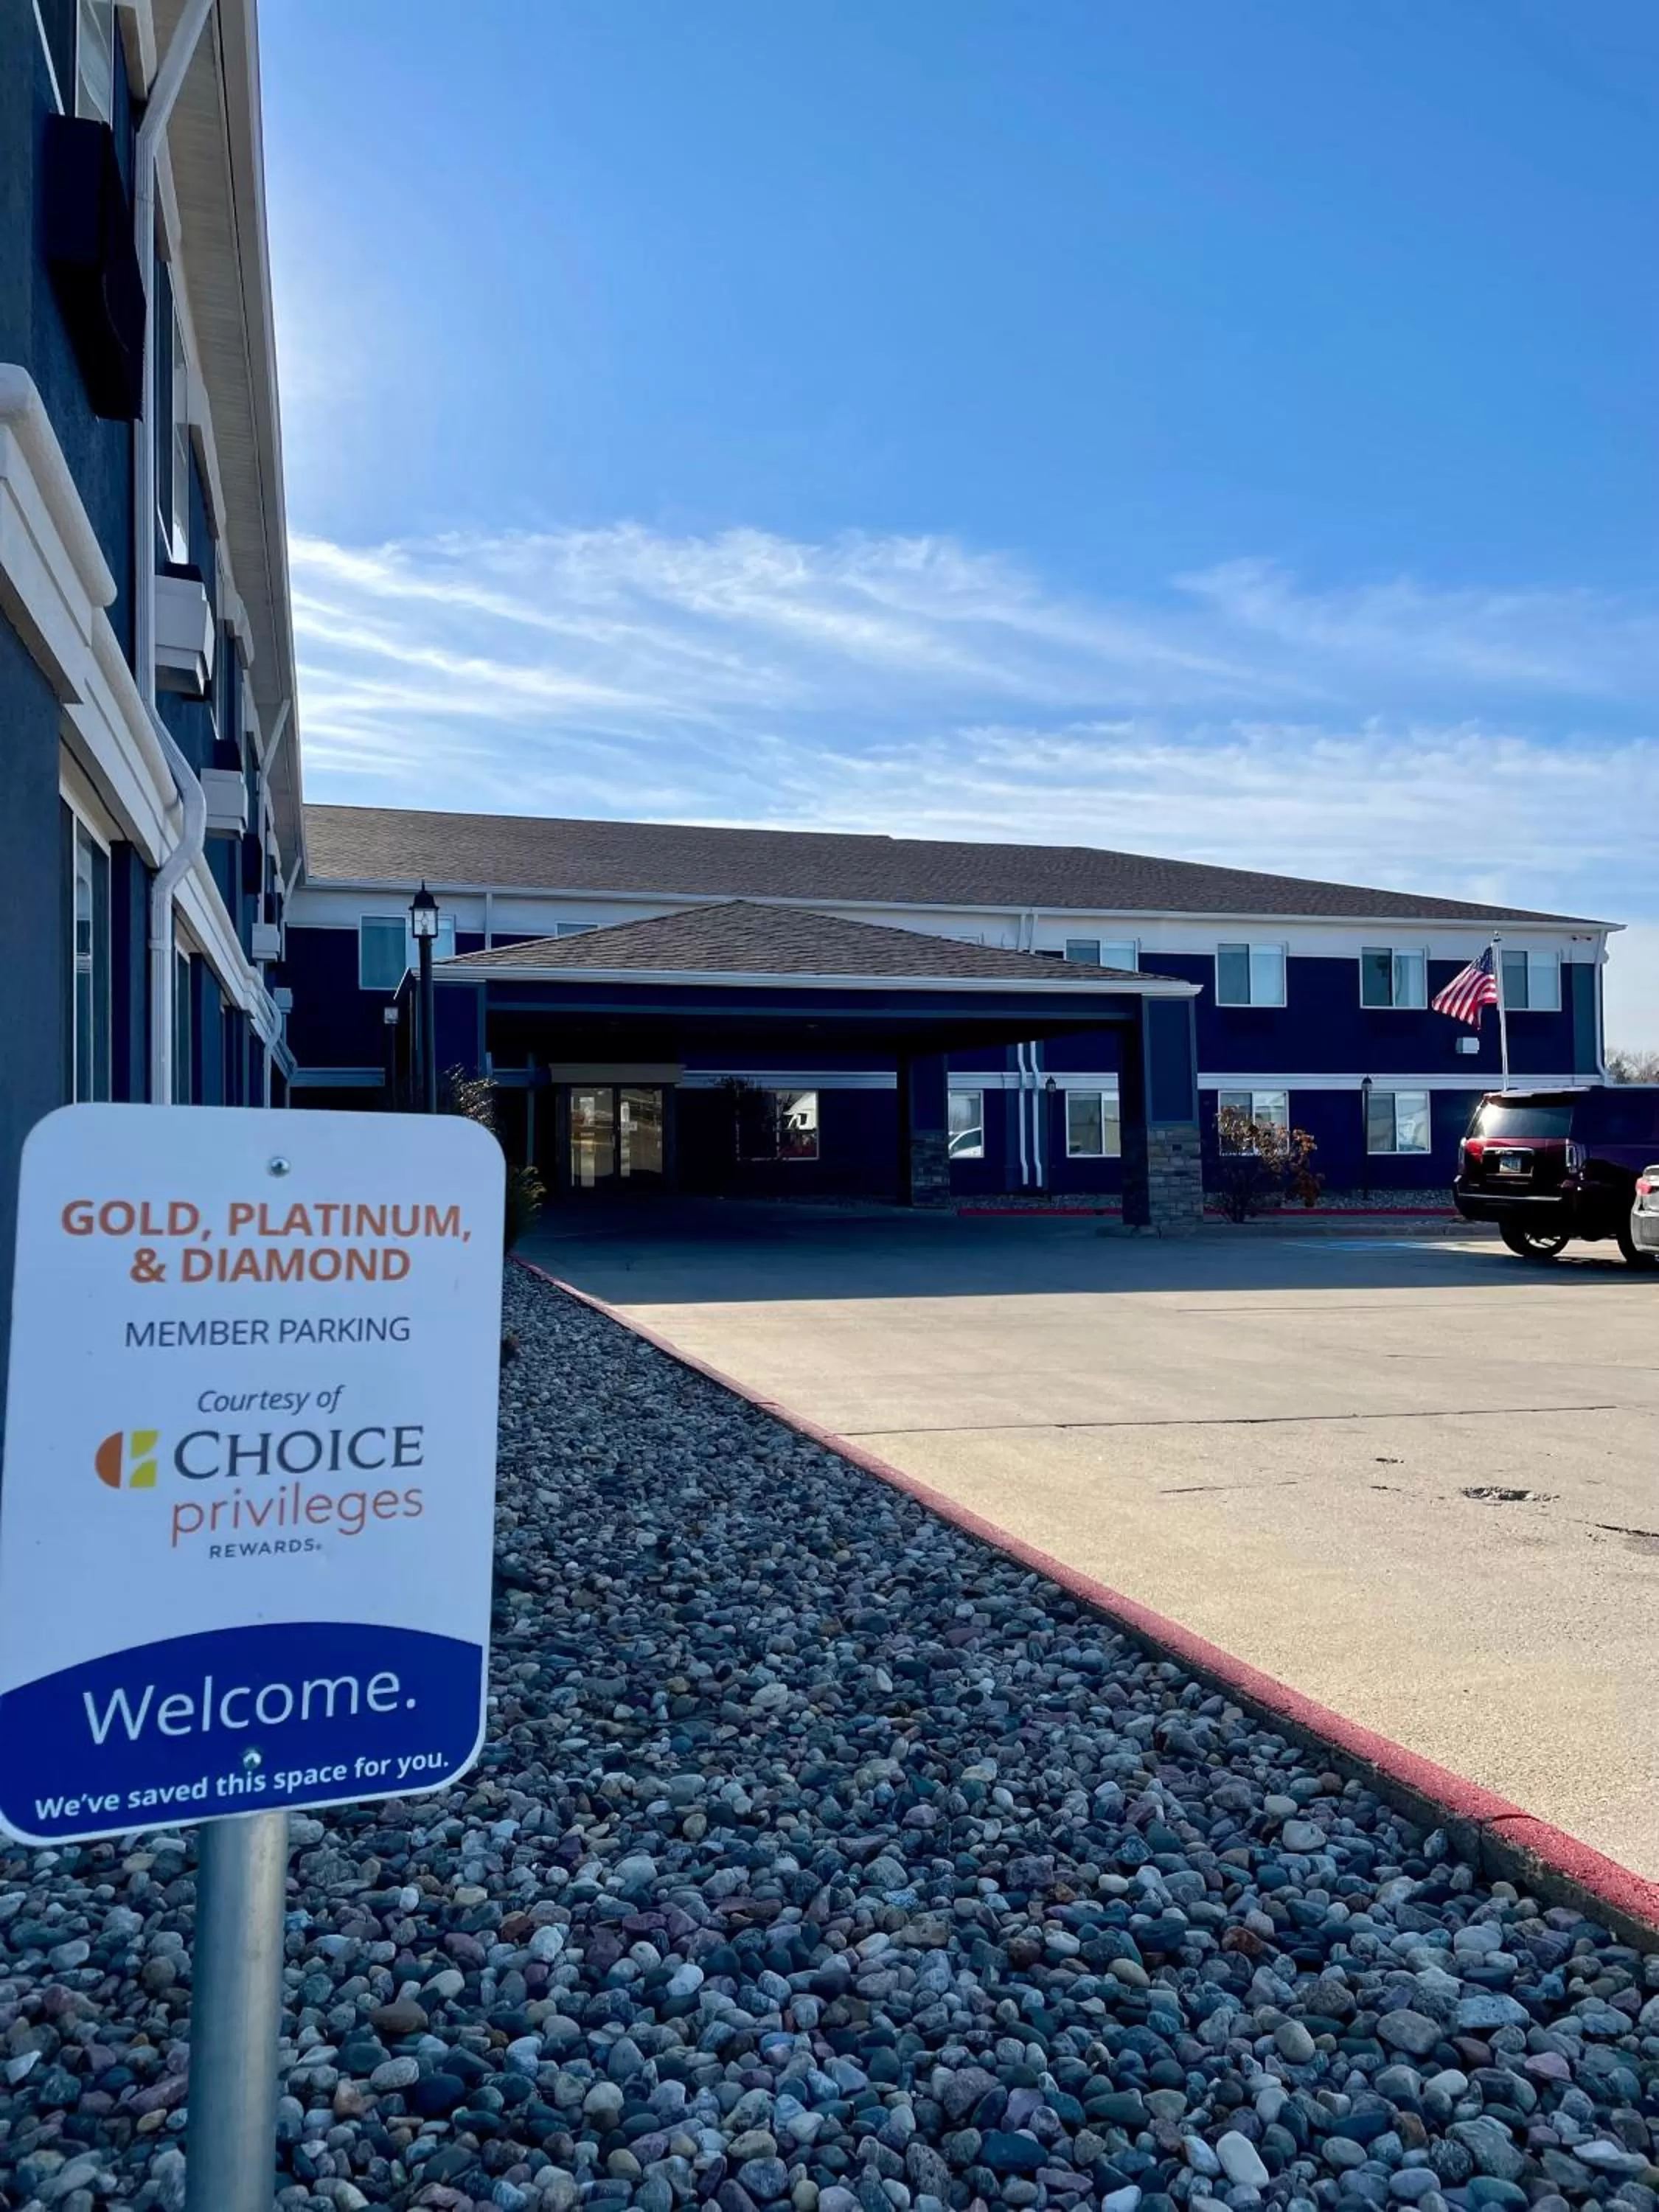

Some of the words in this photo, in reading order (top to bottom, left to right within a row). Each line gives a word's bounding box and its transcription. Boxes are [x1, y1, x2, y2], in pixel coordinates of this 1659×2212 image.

[61, 1200, 212, 1241] GOLD,
[228, 1203, 471, 1242] PLATINUM,
[130, 1248, 166, 1283] &
[181, 1248, 411, 1282] DIAMOND
[125, 1320, 268, 1347] MEMBER
[279, 1317, 411, 1343] PARKING
[197, 1389, 310, 1415] Courtesy
[316, 1385, 346, 1413] of
[173, 1425, 424, 1480] CHOICE
[172, 1481, 423, 1547] privileges
[83, 1670, 416, 1745] Welcome.
[35, 1793, 120, 1820] We’ve
[128, 1777, 208, 1808] saved
[216, 1770, 266, 1796] this
[274, 1764, 347, 1794] space
[355, 1756, 392, 1779] for
[397, 1752, 449, 1783] you.
